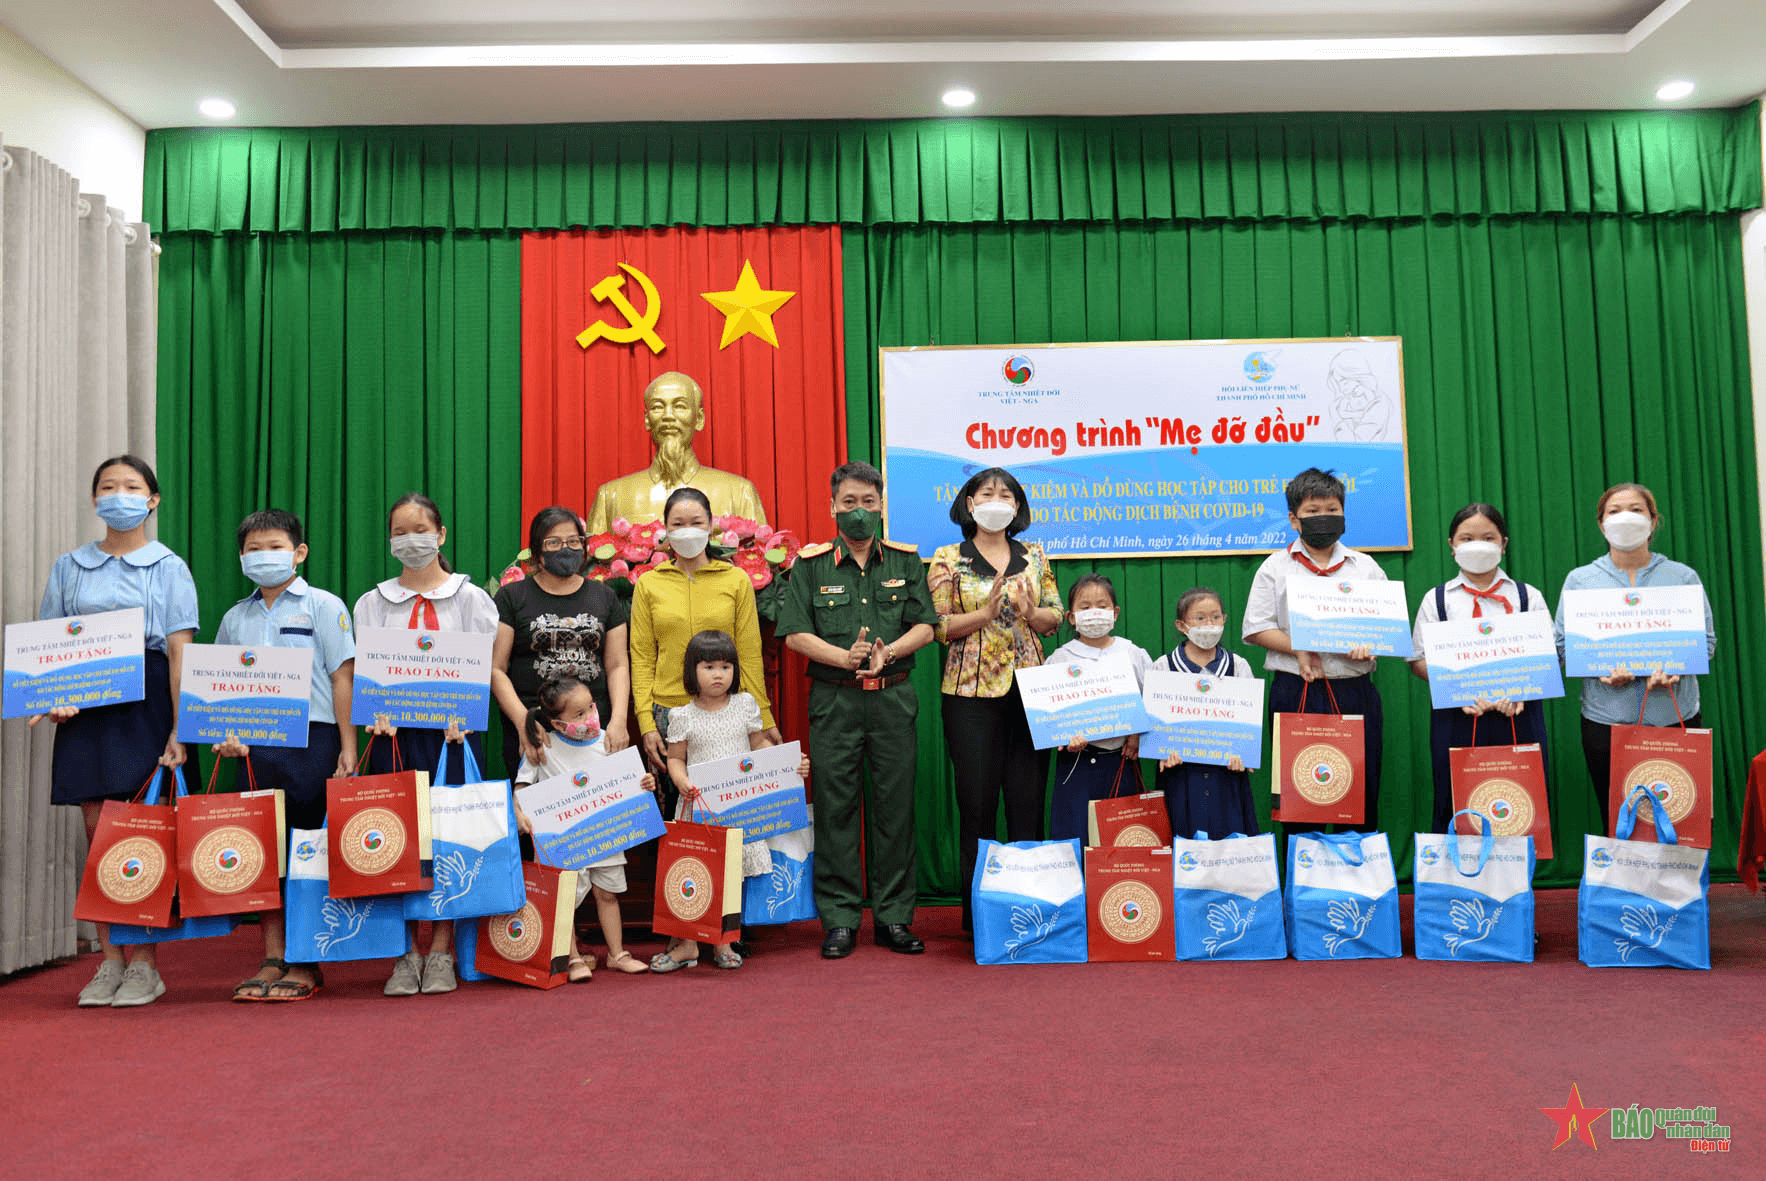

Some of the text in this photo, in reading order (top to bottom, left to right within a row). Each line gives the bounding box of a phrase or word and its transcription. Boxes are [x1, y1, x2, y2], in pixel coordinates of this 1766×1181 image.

[965, 422, 1067, 456] Chương
[1076, 418, 1141, 447] trình
[1211, 416, 1247, 444] đỡ
[1031, 480, 1067, 502] KIỆM
[1071, 479, 1090, 498] VÀ
[1093, 476, 1112, 498] ĐỒ
[1116, 477, 1153, 498] DÙNG
[1158, 480, 1188, 501] HỌC
[1190, 476, 1217, 500] TẬP
[1219, 479, 1249, 495] CHO
[1251, 474, 1280, 494] TRẺ
[1030, 499, 1264, 526] DO TÁC ĐỘNG DỊCH BỆNH COVID-19
[1047, 535, 1069, 552] phố
[1070, 534, 1086, 549] Hồ
[1088, 534, 1110, 549] Chí
[1113, 533, 1145, 549] Minh,
[1148, 535, 1173, 550] ngày
[1176, 535, 1189, 546] 26
[1191, 533, 1222, 549] tháng
[1225, 533, 1232, 545] 4
[1235, 533, 1256, 546] năm
[1261, 533, 1286, 545] 2022
[37, 654, 73, 664] TRAO
[386, 666, 460, 679] TRAO TẶNG
[211, 682, 281, 694] TRAO TẶNG
[1170, 705, 1201, 715] TRAO
[718, 789, 748, 802] TRAO
[556, 789, 623, 822] TRAO TẶNG
